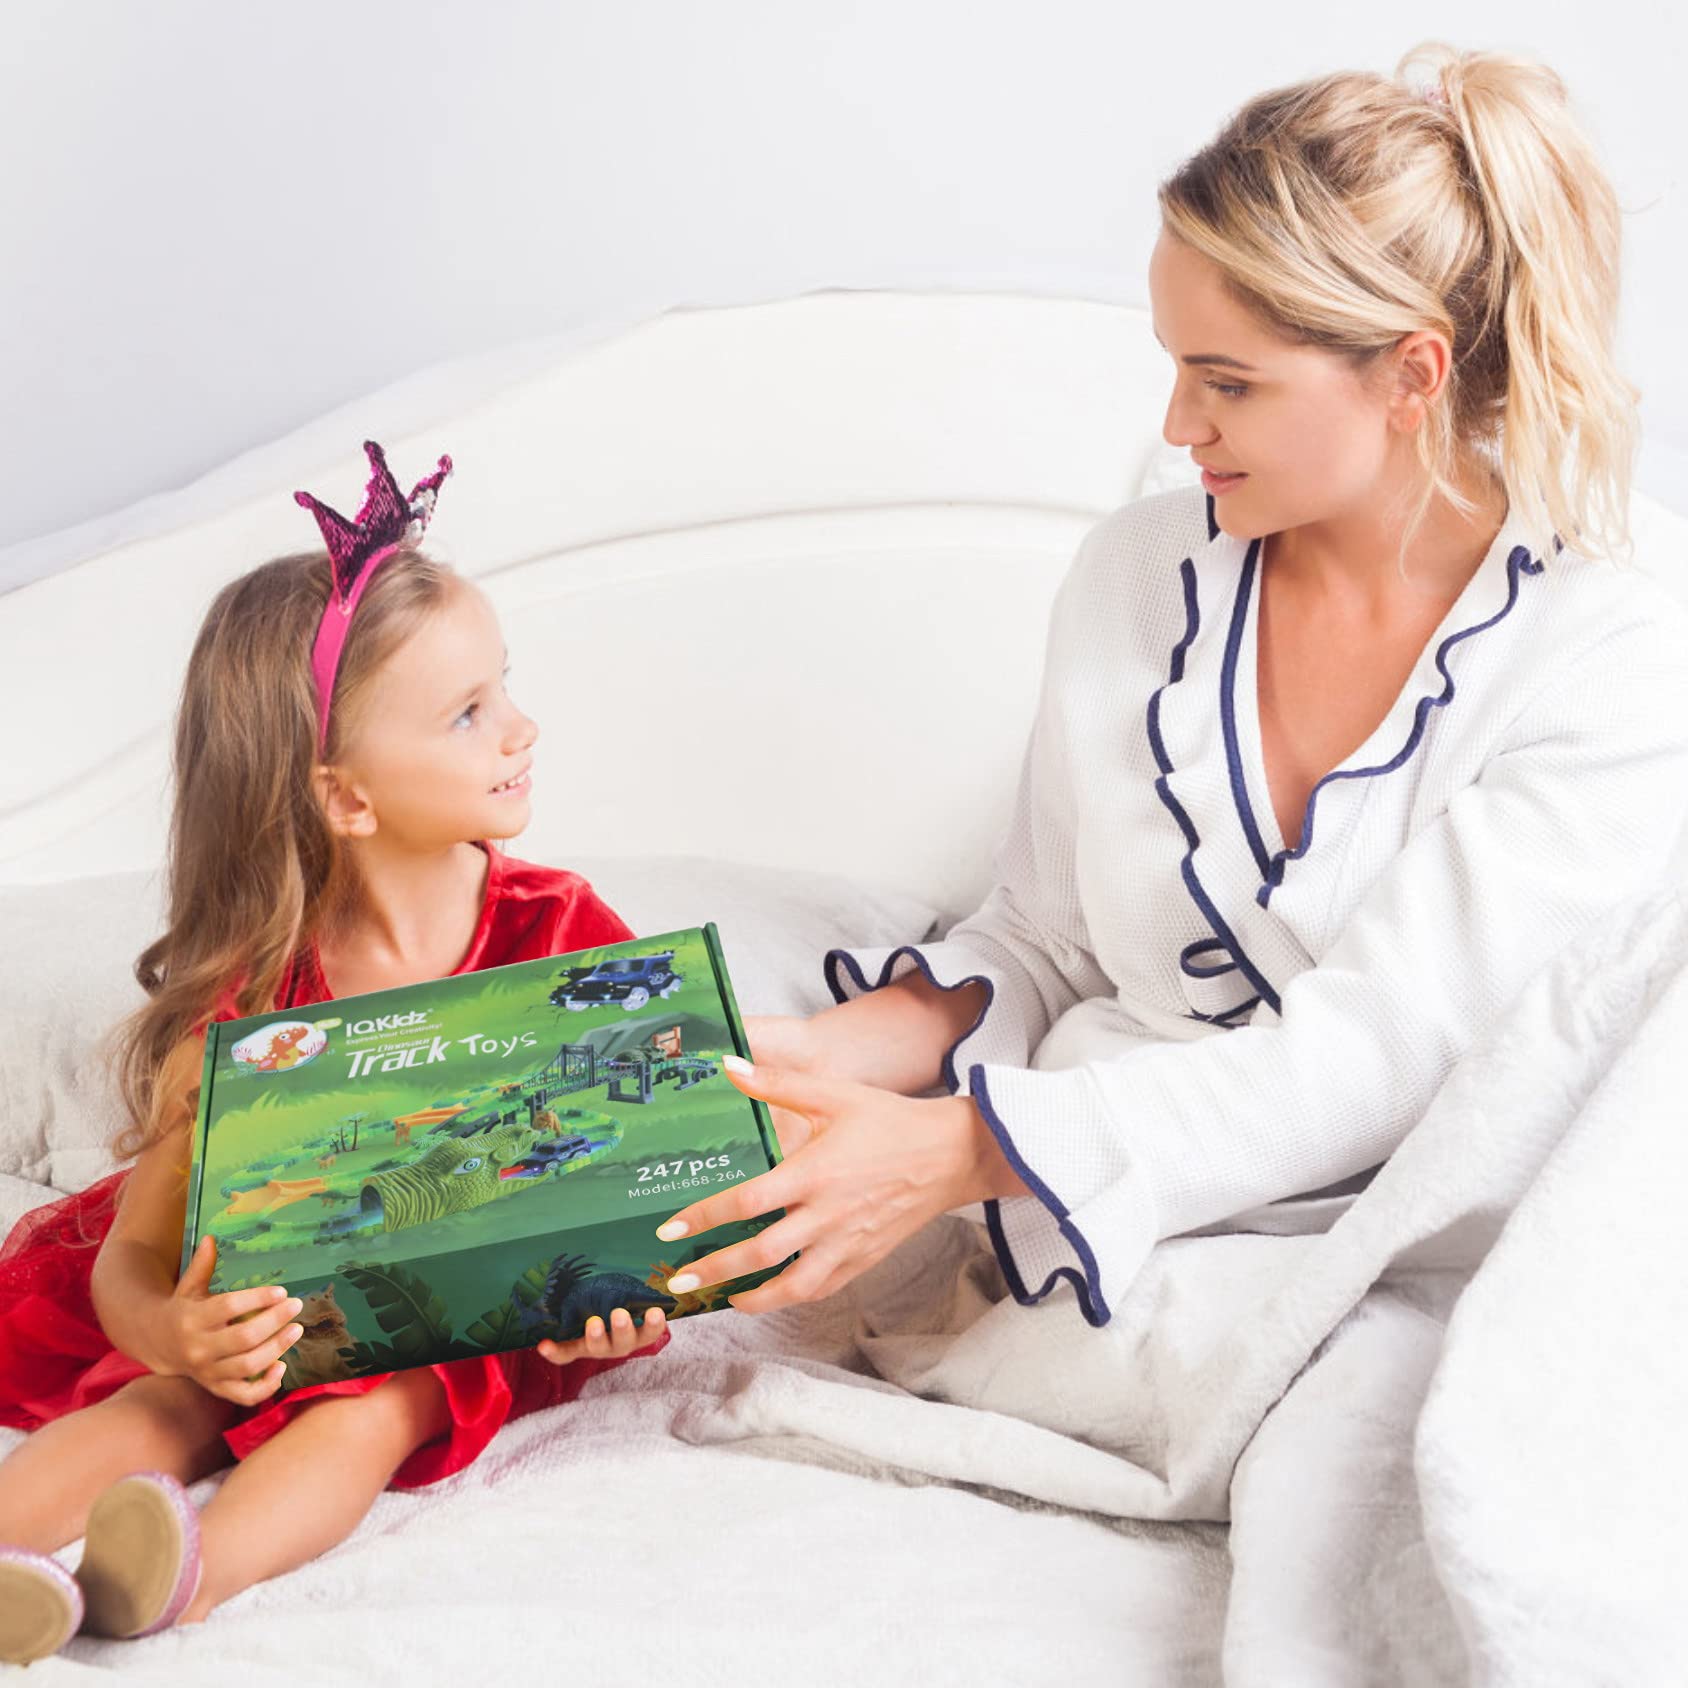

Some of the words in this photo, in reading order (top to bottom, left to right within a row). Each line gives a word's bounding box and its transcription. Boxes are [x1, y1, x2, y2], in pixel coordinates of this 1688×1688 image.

[346, 1011, 427, 1037] IQKidz
[345, 1036, 450, 1079] Track
[457, 1031, 538, 1058] Toys
[636, 1160, 684, 1182] 247
[688, 1154, 730, 1176] pcs
[628, 1169, 746, 1199] Model:668-26A
